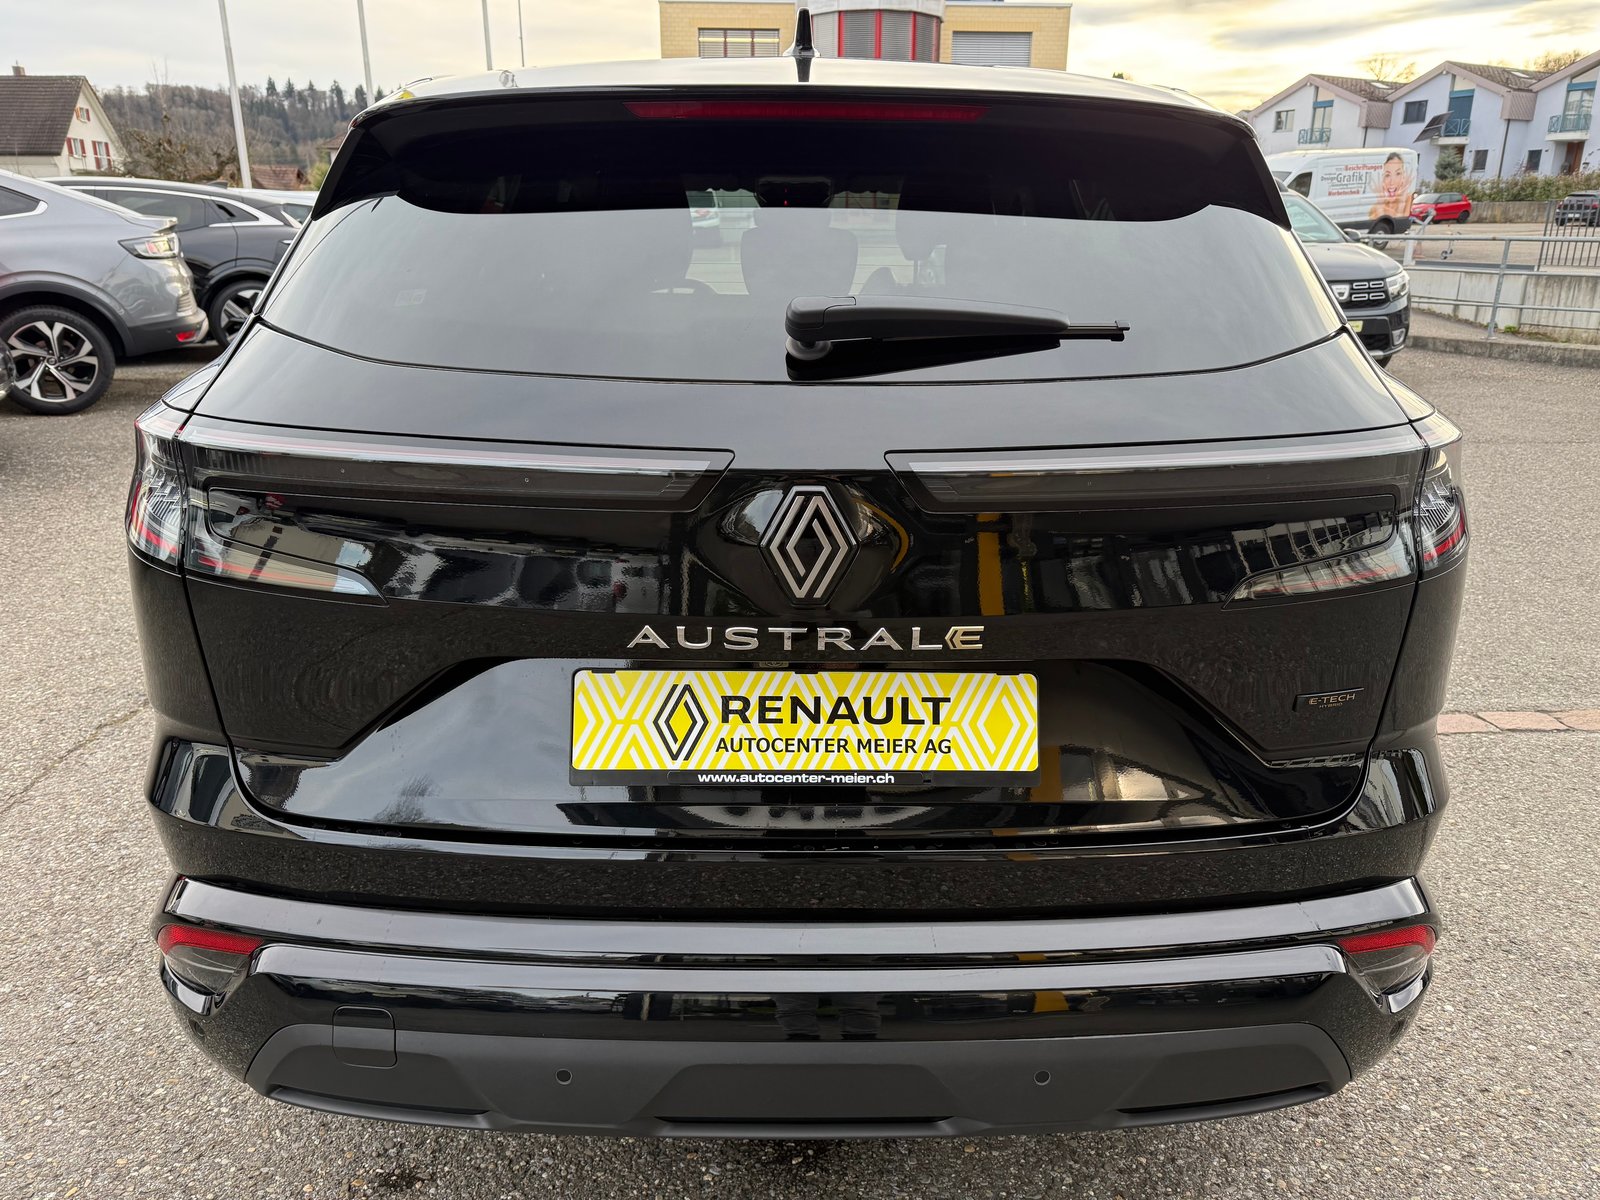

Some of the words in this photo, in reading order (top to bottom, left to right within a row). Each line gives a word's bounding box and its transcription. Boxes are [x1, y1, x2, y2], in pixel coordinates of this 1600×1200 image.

[1336, 171, 1364, 183] Grafik
[1308, 692, 1356, 705] E-TECH
[720, 695, 952, 726] RENAULT
[715, 737, 848, 754] AUTOCENTER
[856, 738, 918, 754] MEIER
[923, 738, 952, 755] AG
[697, 772, 896, 785] www.autocenter-meier.ch
